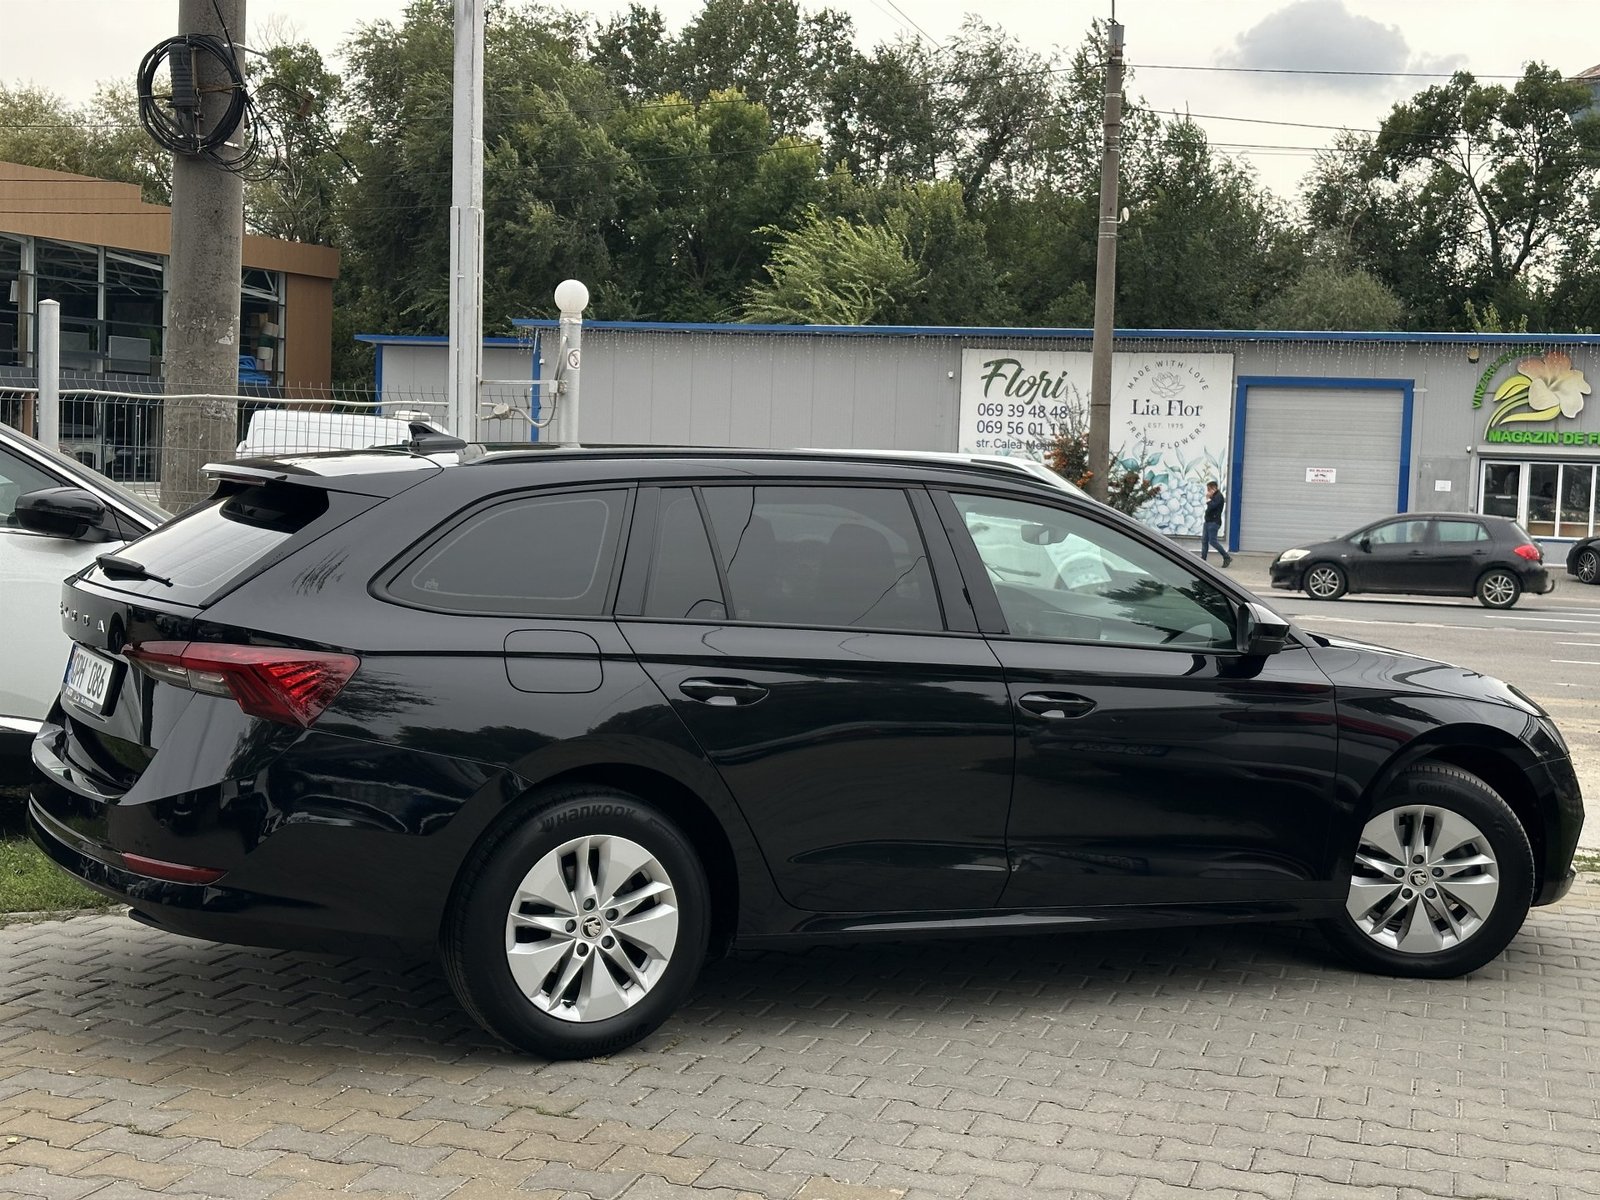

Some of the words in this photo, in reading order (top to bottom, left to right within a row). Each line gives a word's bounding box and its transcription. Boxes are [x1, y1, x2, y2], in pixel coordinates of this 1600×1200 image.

[981, 358, 1068, 406] Flori
[1127, 365, 1151, 390] MADE
[1155, 360, 1184, 369] WITH
[1188, 367, 1209, 391] LOVE
[1472, 362, 1499, 410] VINZAR
[977, 402, 1004, 417] 069
[1007, 403, 1025, 418] 39
[1028, 405, 1047, 419] 48
[1049, 405, 1069, 420] 48
[1130, 399, 1161, 416] Lia
[1165, 399, 1204, 417] Flor
[976, 420, 1003, 434] 069
[1007, 421, 1024, 435] 56
[1027, 422, 1045, 437] 01
[1160, 422, 1206, 450] FLOWERS
[1488, 430, 1559, 444] MAGAZIN
[1563, 431, 1585, 445] DE
[1588, 432, 1600, 445] F
